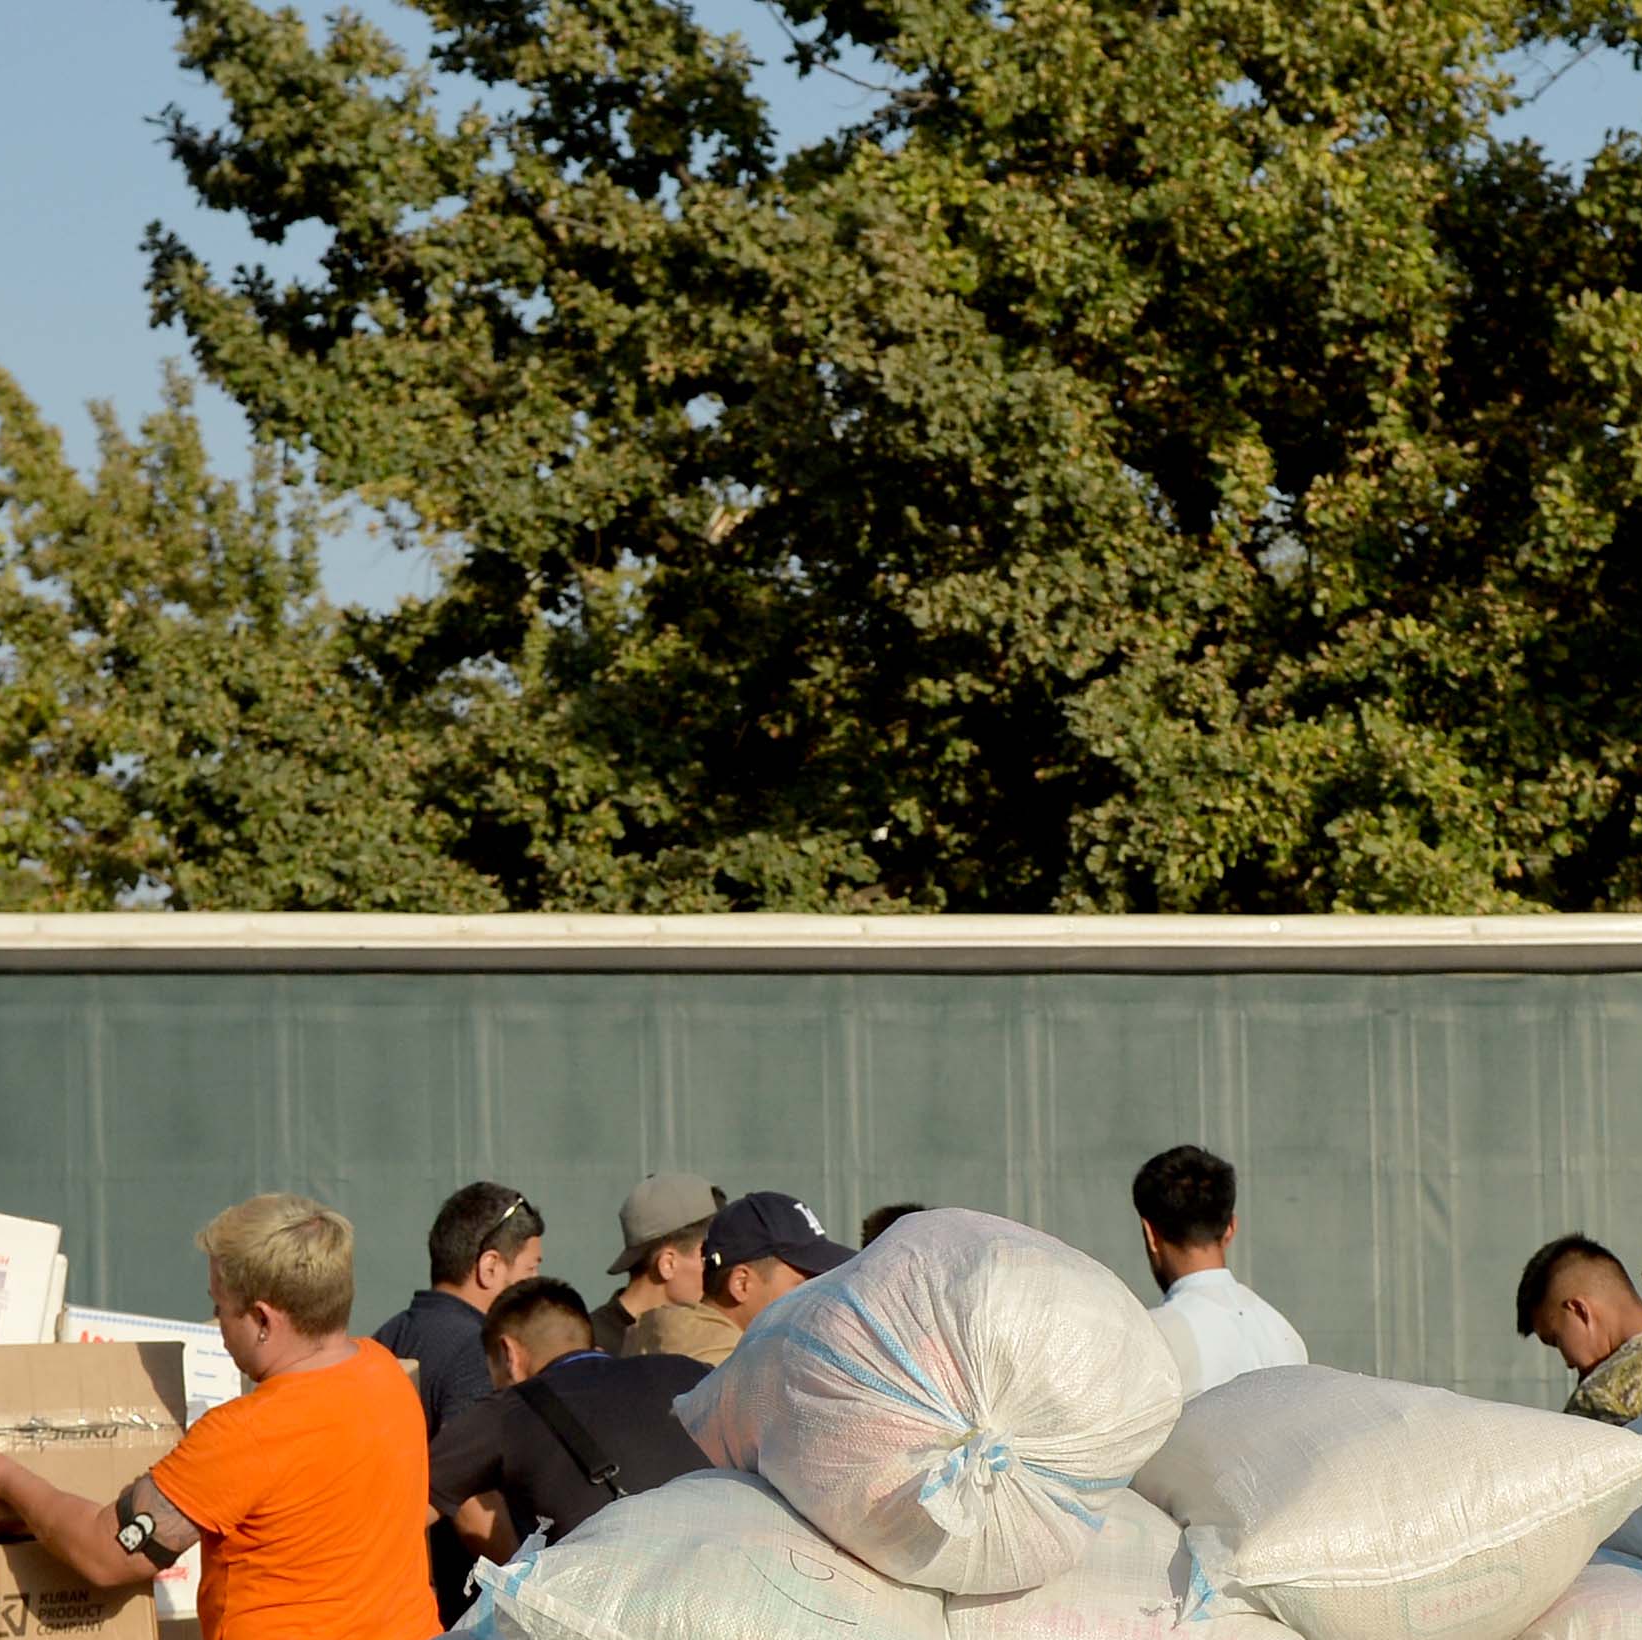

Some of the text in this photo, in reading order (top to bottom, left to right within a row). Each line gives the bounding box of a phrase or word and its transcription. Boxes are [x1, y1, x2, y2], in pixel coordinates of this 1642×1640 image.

[39, 1591, 89, 1605] KUBAN
[37, 1604, 104, 1620] PRODUCT
[36, 1620, 103, 1636] COMPANY
